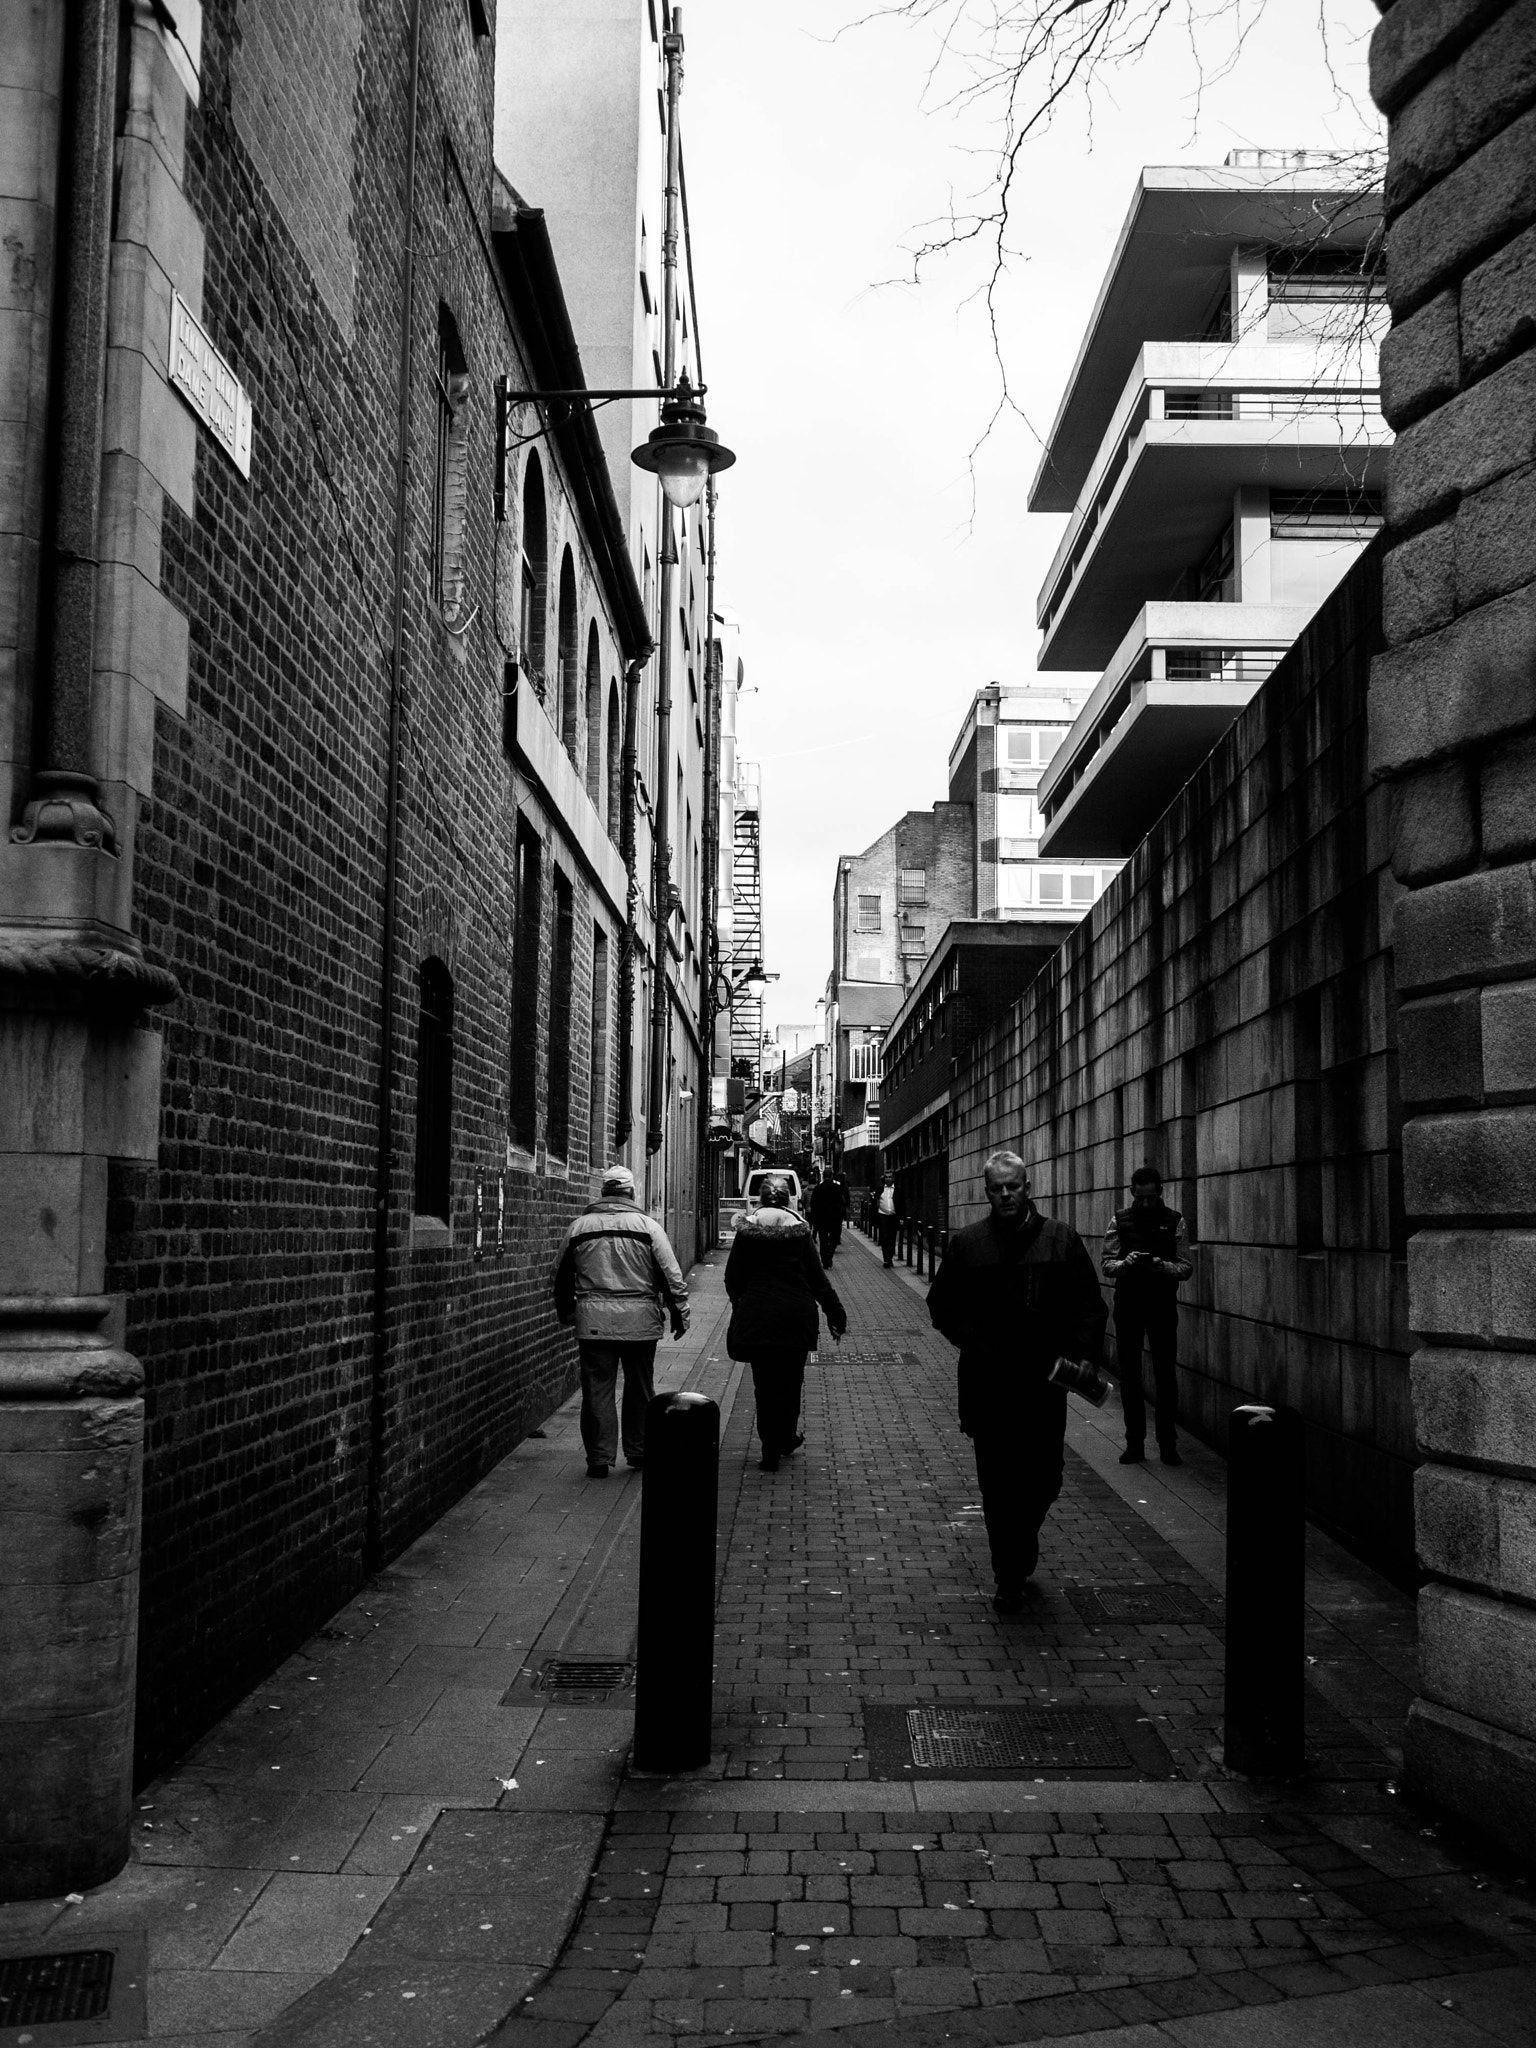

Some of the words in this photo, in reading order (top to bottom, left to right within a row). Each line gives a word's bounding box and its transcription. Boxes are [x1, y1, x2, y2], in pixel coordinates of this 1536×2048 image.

[202, 348, 212, 382] AN
[176, 350, 205, 409] DAME
[208, 394, 233, 447] LANE
